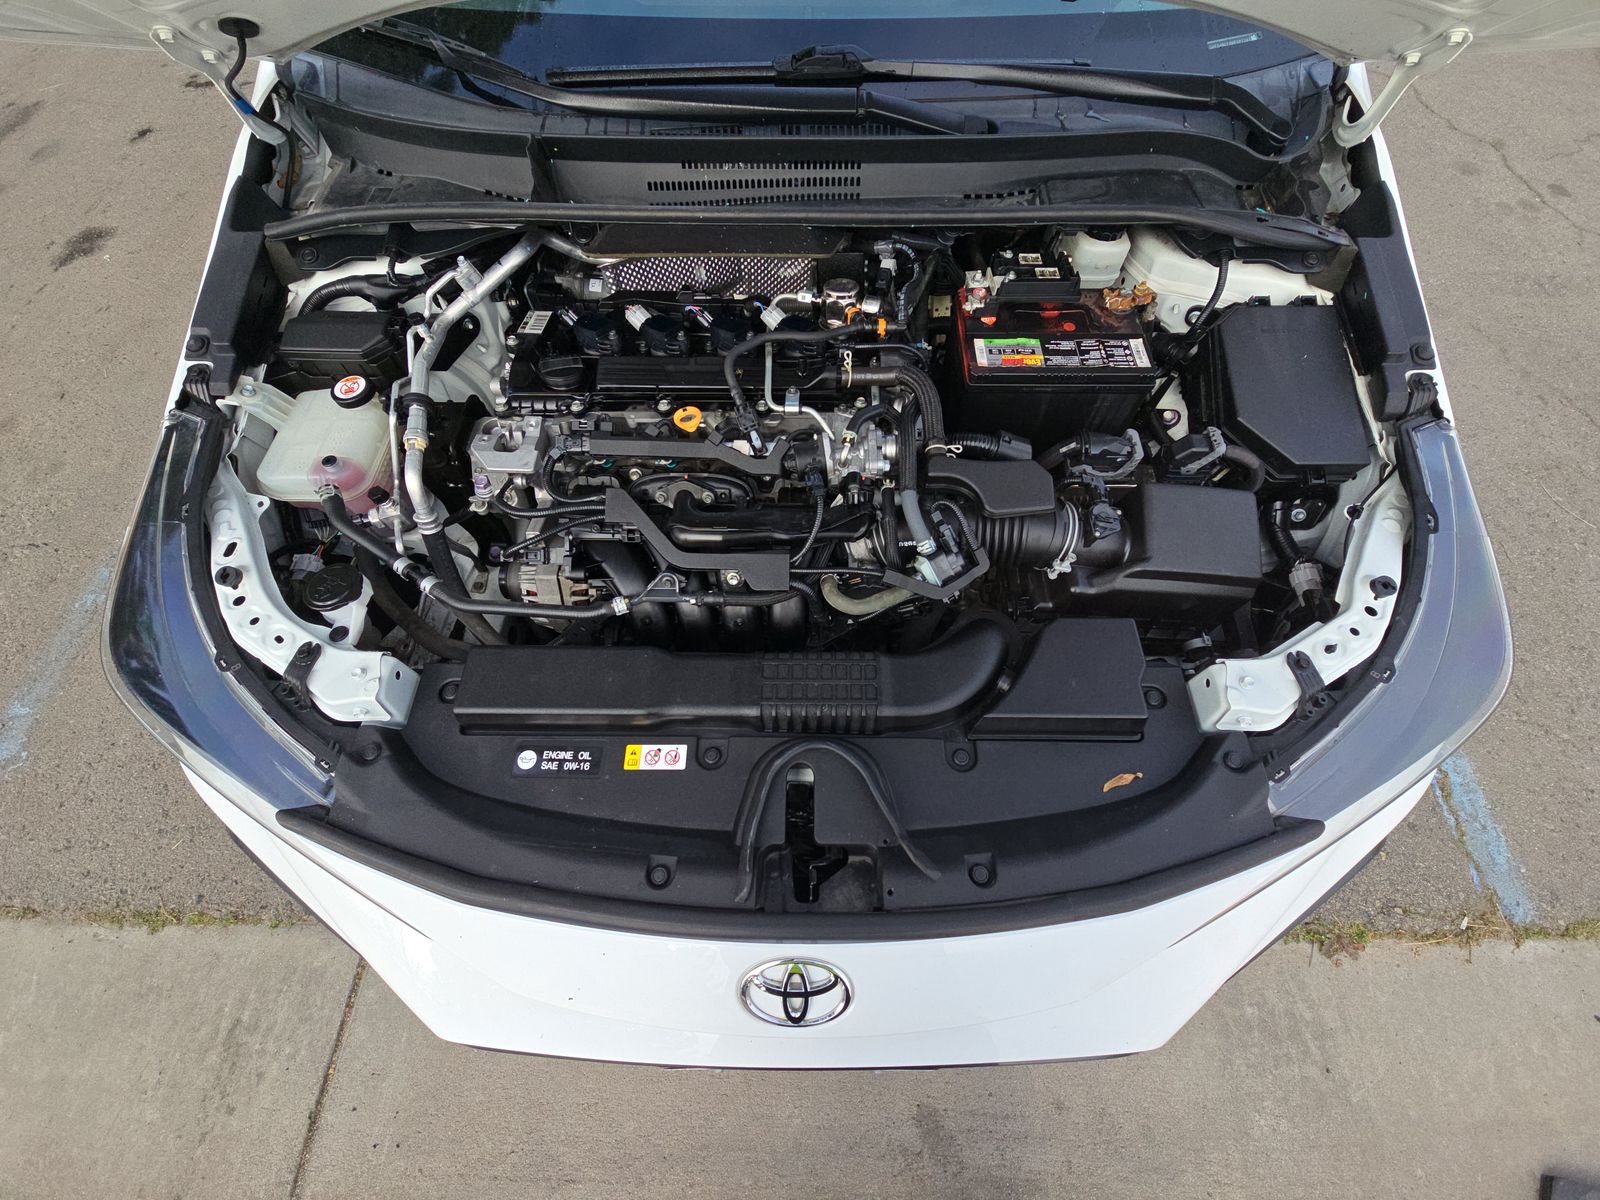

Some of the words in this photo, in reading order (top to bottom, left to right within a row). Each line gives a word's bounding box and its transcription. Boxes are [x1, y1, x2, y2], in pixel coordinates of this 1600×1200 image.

[542, 750, 574, 760] ENGINE
[578, 751, 592, 760] OIL
[540, 761, 559, 770] SAE
[563, 761, 591, 771] 0W-16
